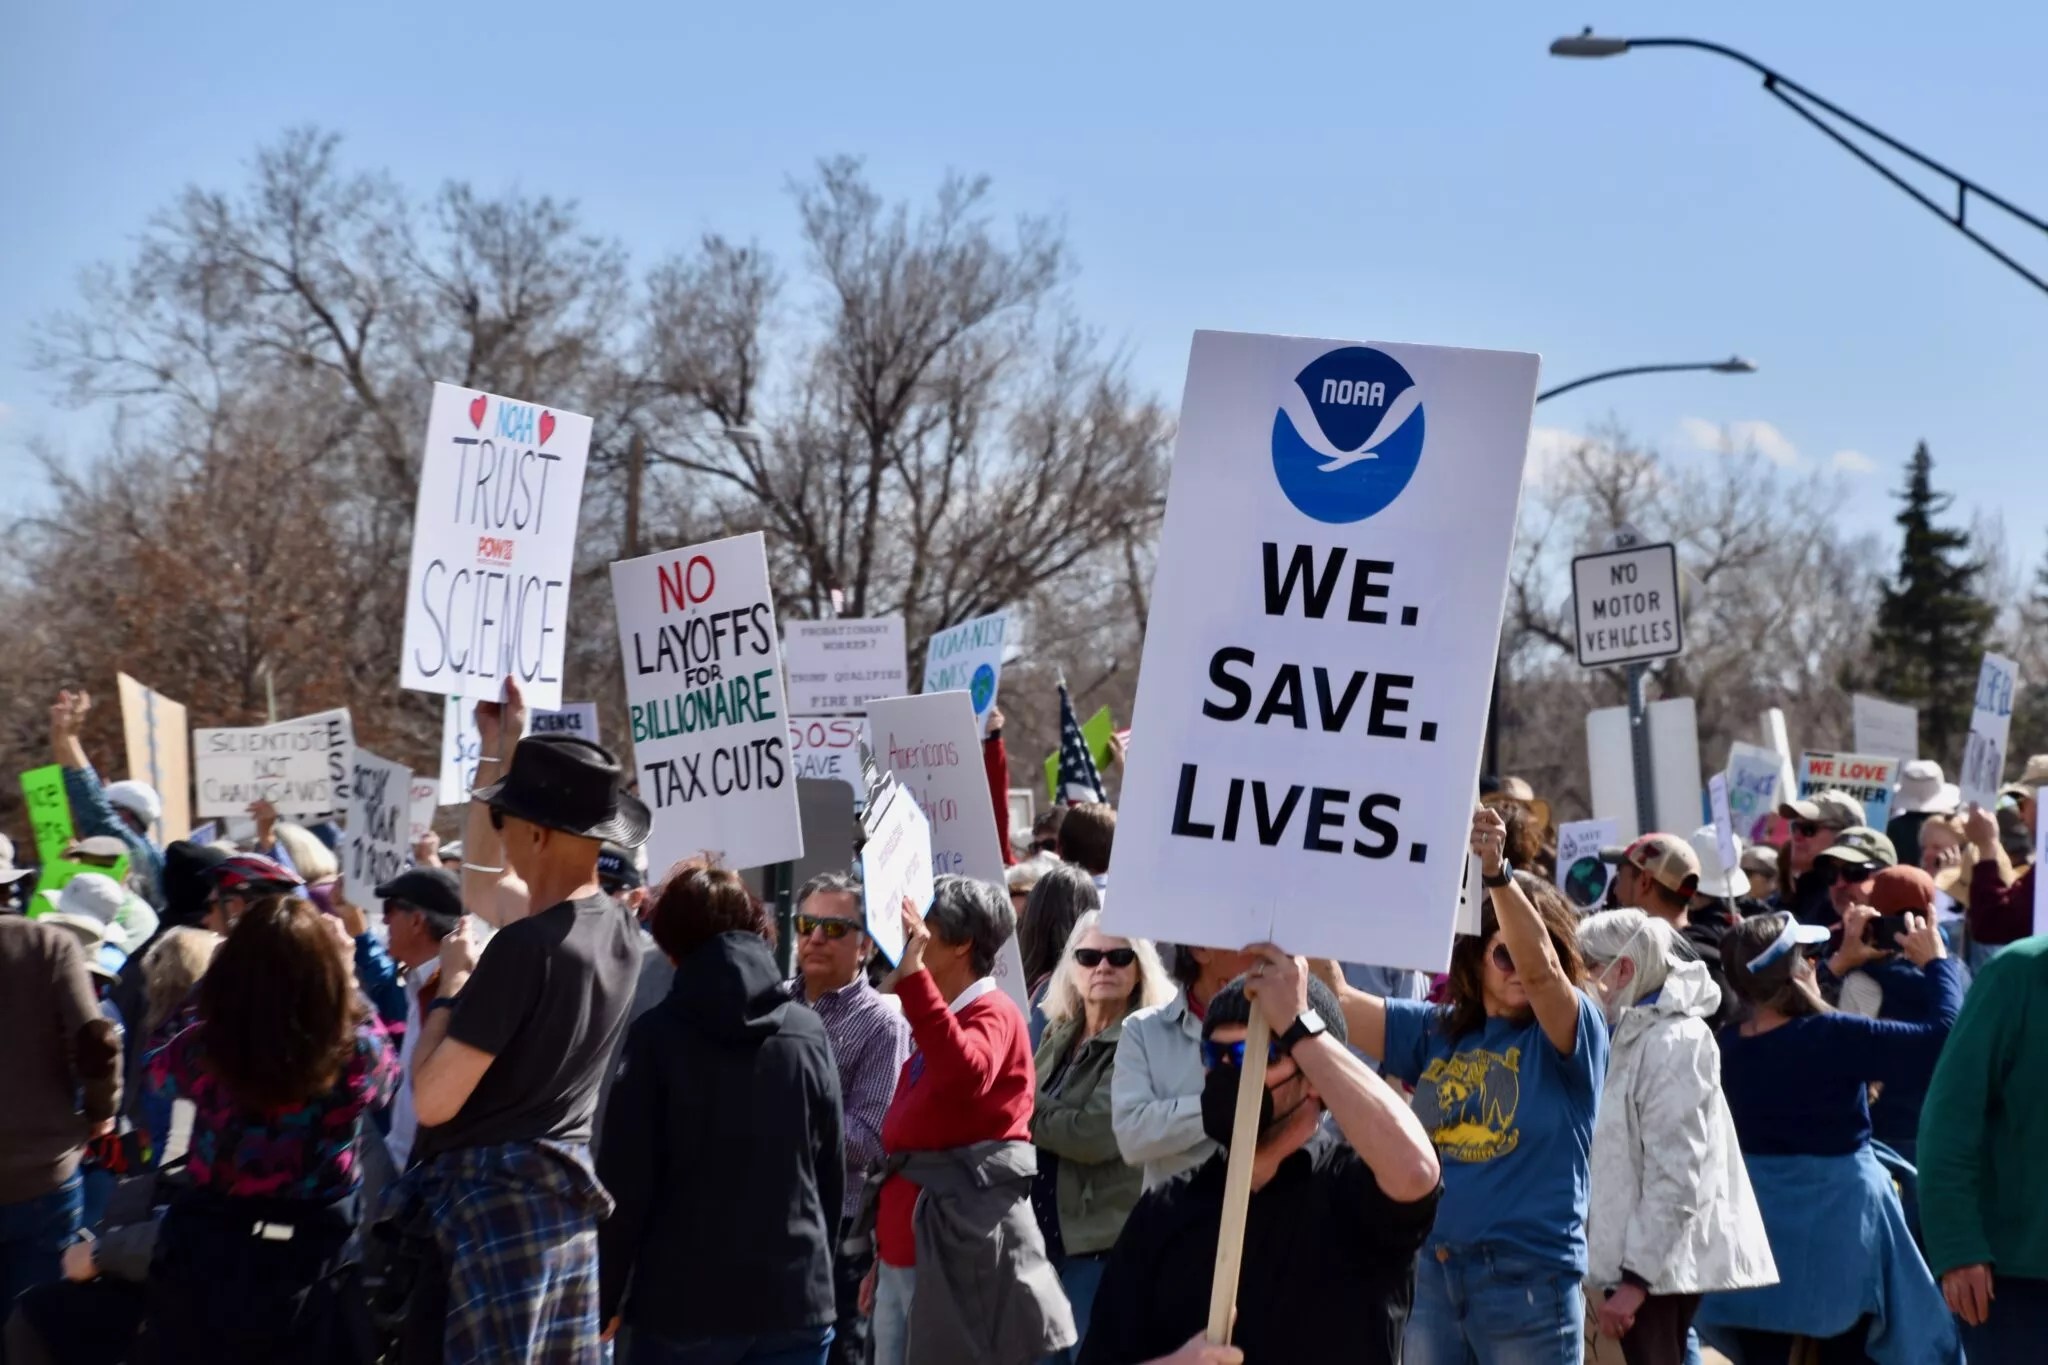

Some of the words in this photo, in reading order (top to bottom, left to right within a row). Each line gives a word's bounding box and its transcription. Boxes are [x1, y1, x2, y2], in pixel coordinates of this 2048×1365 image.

[1321, 379, 1386, 407] NOAA
[496, 401, 534, 444] NOAA
[453, 437, 561, 534] TRUST
[657, 555, 716, 613] NO
[1263, 542, 1419, 627] WE.
[1610, 563, 1638, 586] NO
[415, 559, 562, 683] SCIENCE
[1593, 590, 1661, 620] MOTOR
[634, 602, 770, 676] LAYOFFS
[1586, 619, 1673, 653] VEHICLES
[631, 668, 777, 743] BILLIONAIRE
[685, 667, 724, 689] FOR
[811, 696, 848, 708] FIRE
[1202, 647, 1438, 742] SAVE.
[645, 753, 708, 809] TAX
[711, 737, 785, 796] CUTS
[1809, 761, 1835, 776] WE
[1841, 763, 1889, 781] LOVE
[1170, 763, 1428, 864] LIVES.
